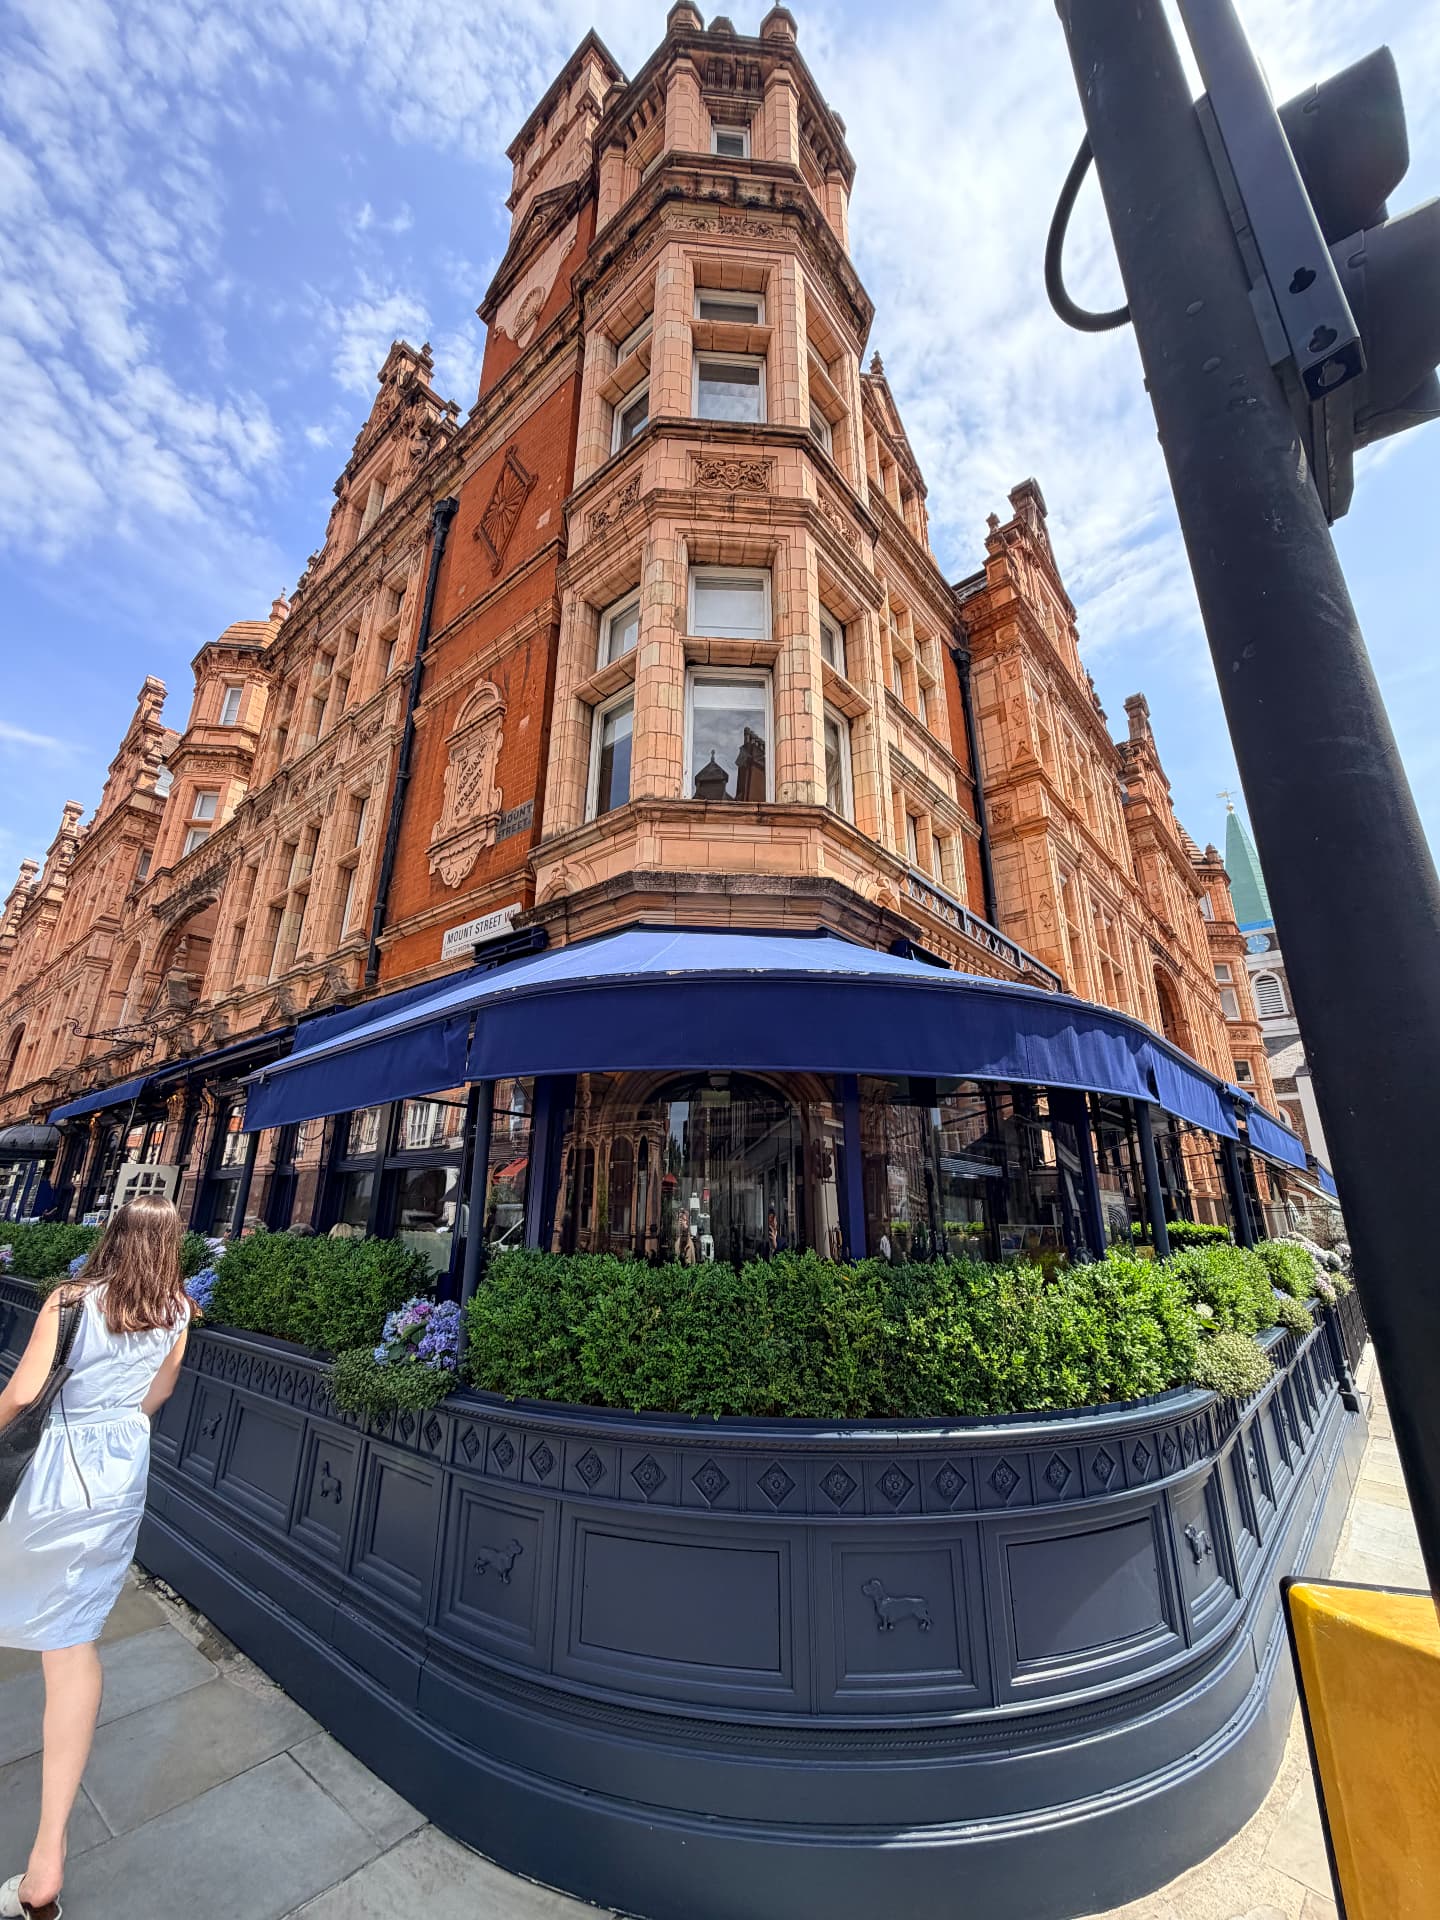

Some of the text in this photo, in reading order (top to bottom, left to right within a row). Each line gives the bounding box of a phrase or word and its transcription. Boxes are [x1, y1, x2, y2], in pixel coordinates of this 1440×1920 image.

[501, 803, 533, 825] MOUNT
[446, 924, 474, 945] MOUNT
[474, 913, 502, 935] STREET
